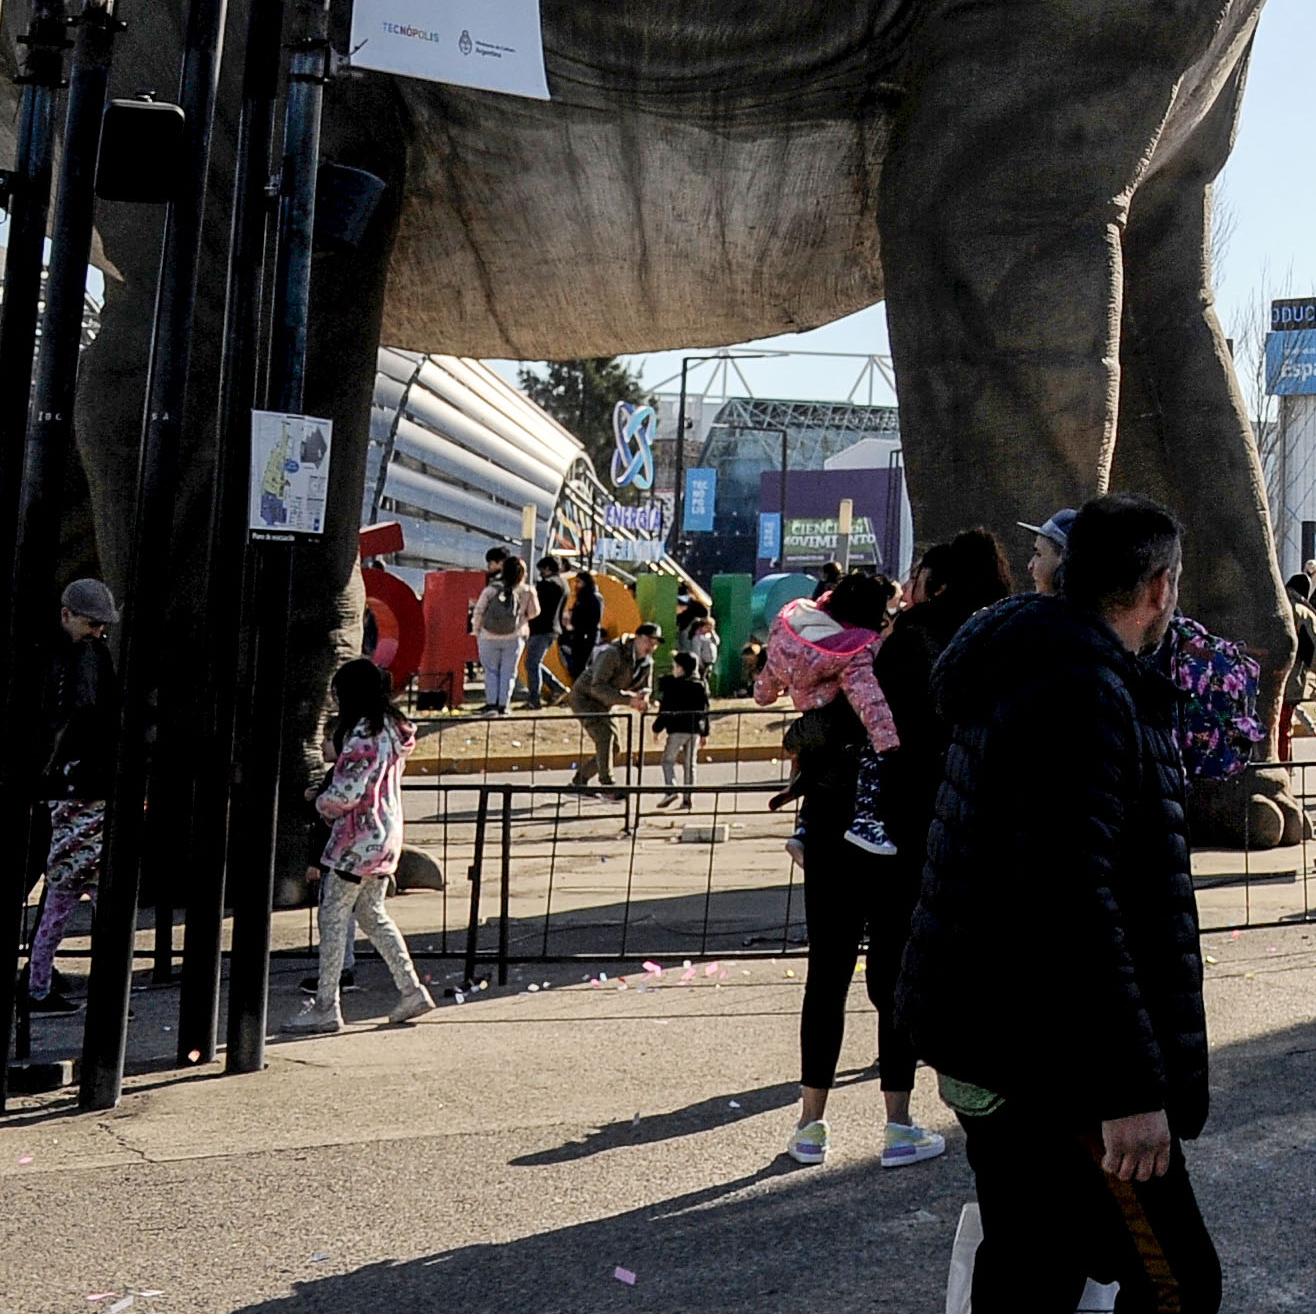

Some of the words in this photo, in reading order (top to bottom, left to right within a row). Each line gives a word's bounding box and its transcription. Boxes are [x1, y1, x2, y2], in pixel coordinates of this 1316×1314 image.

[382, 21, 440, 43] TECNÓPOLIS
[791, 518, 840, 536] CIENCI
[783, 533, 876, 548] MOVIMINTO
